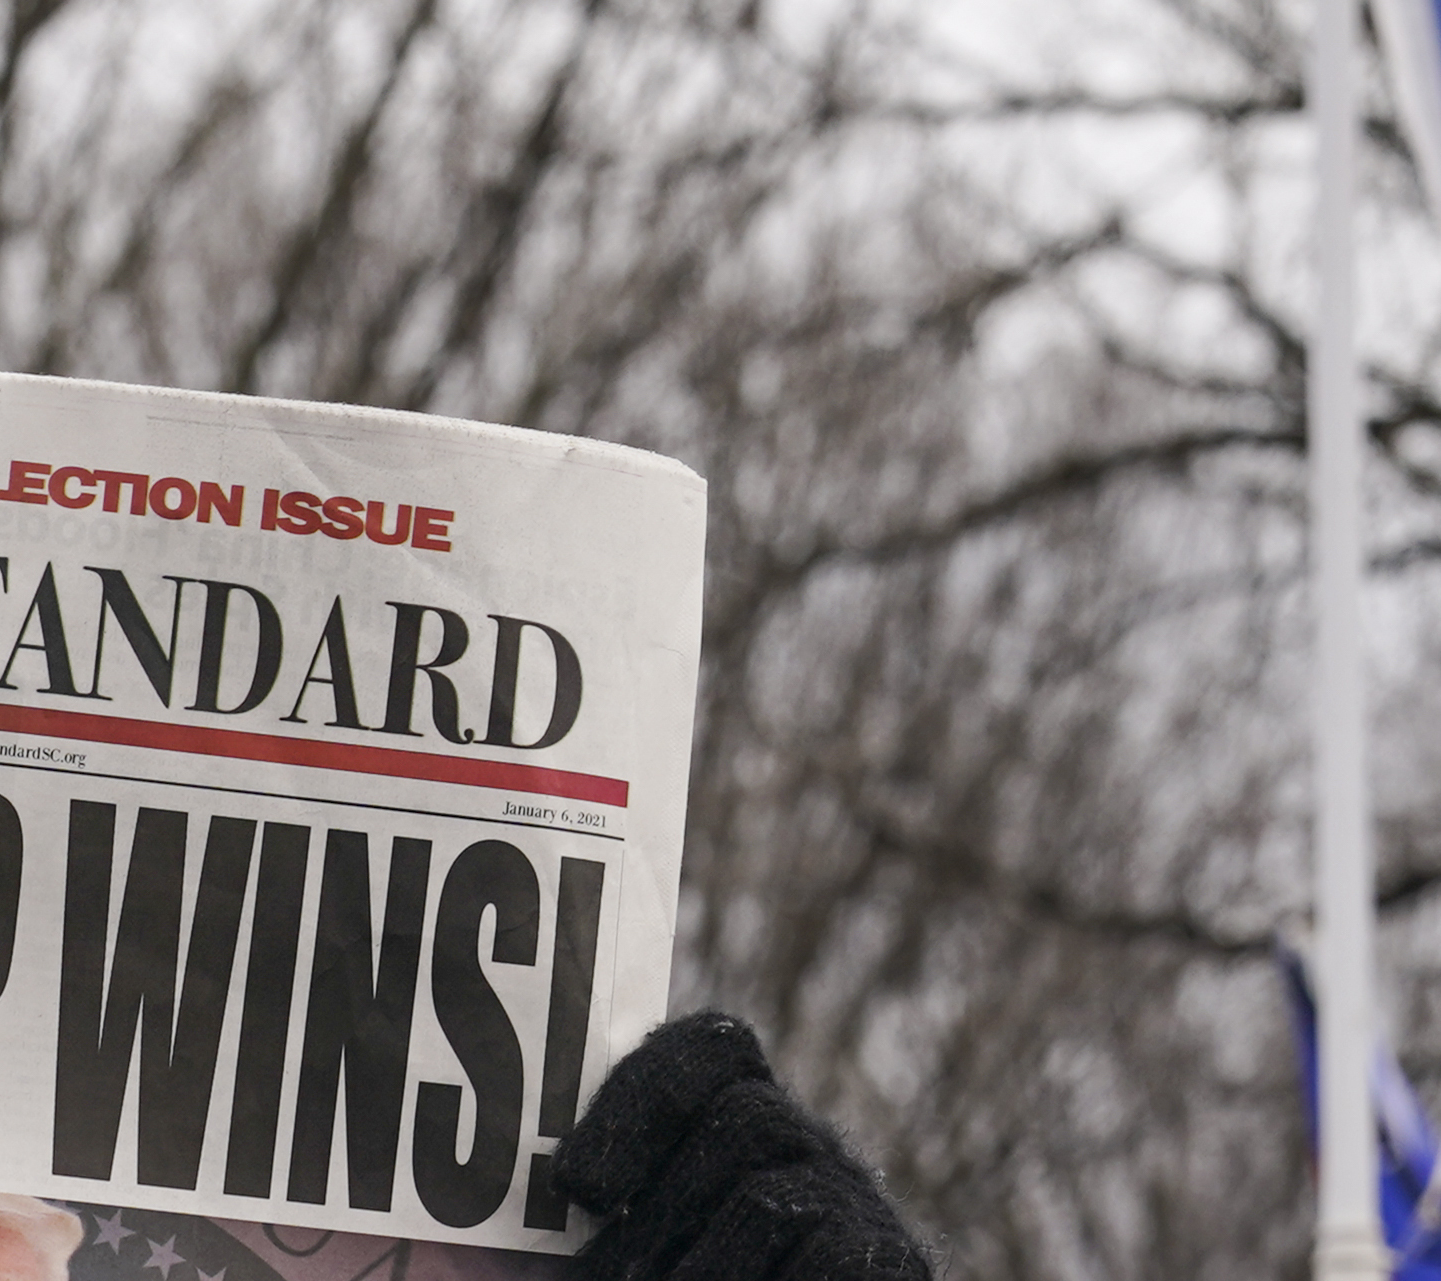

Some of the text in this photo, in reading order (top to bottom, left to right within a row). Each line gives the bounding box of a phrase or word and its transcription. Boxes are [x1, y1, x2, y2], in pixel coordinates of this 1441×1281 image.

[260, 488, 456, 553] ISSUE
[501, 802, 608, 828] January 6, 2021
[50, 800, 606, 1232] WINS!
